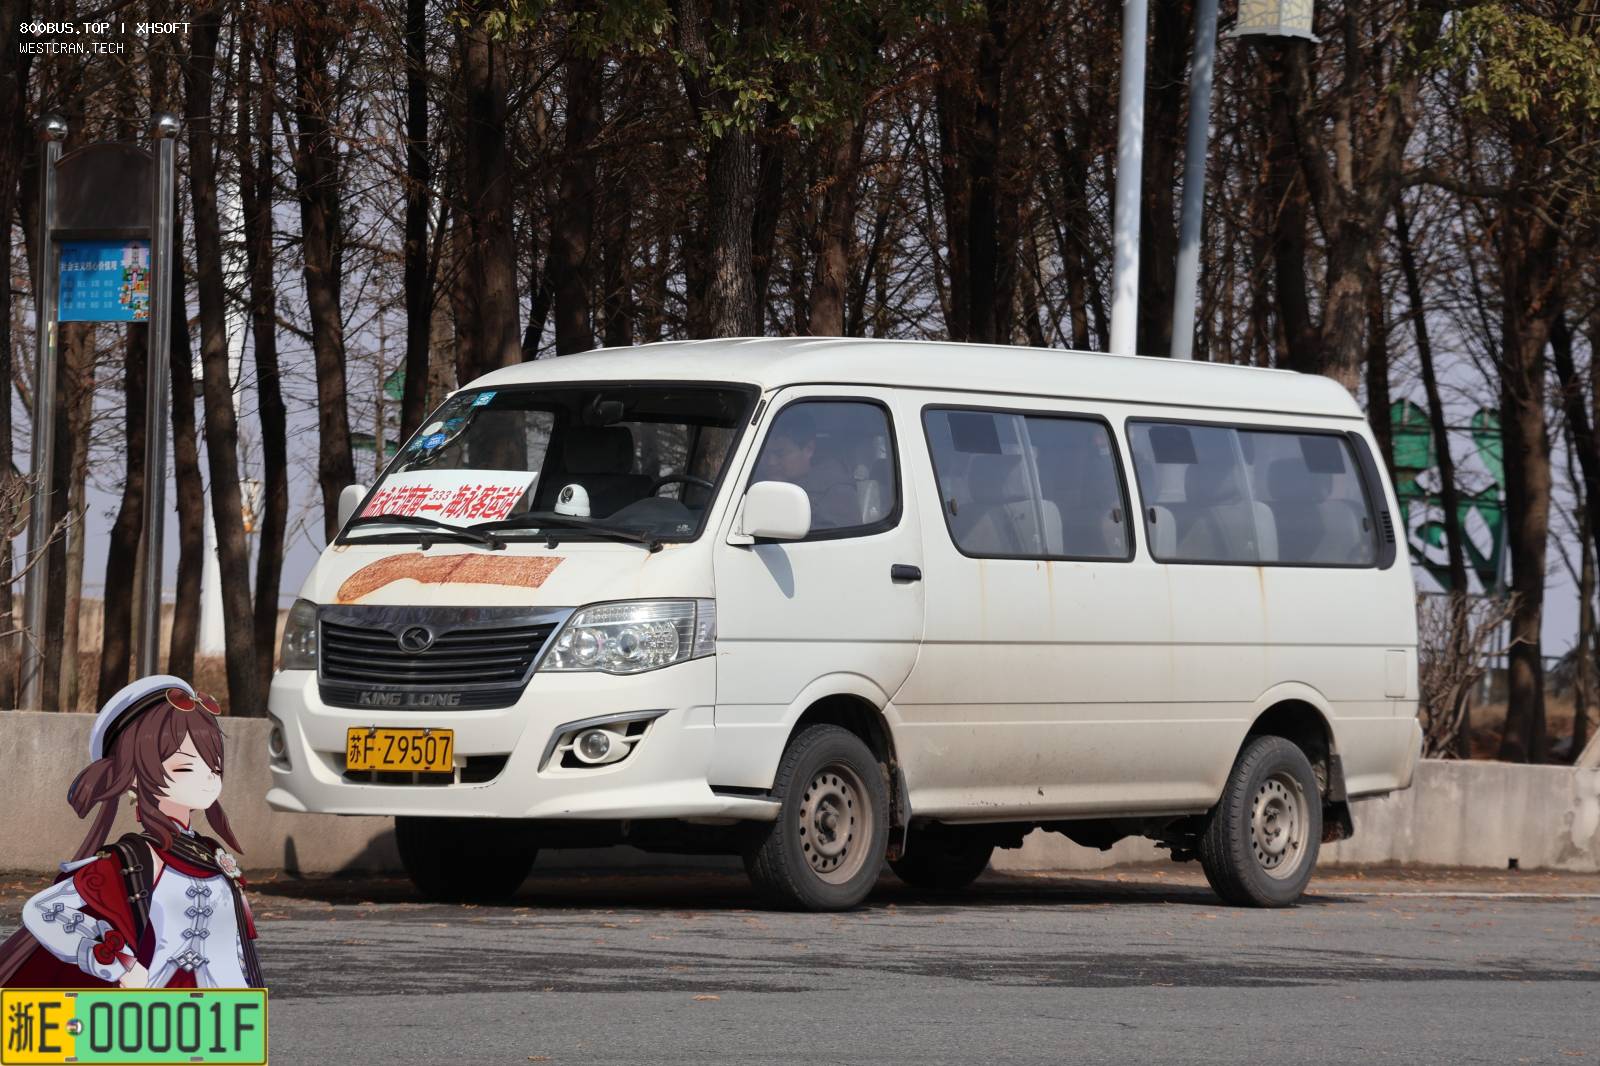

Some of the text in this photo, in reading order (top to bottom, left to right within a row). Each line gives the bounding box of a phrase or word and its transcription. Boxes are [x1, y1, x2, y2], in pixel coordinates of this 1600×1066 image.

[428, 490, 452, 501] 333
[440, 484, 524, 521] 海永客运站
[359, 691, 462, 706] KING LONG
